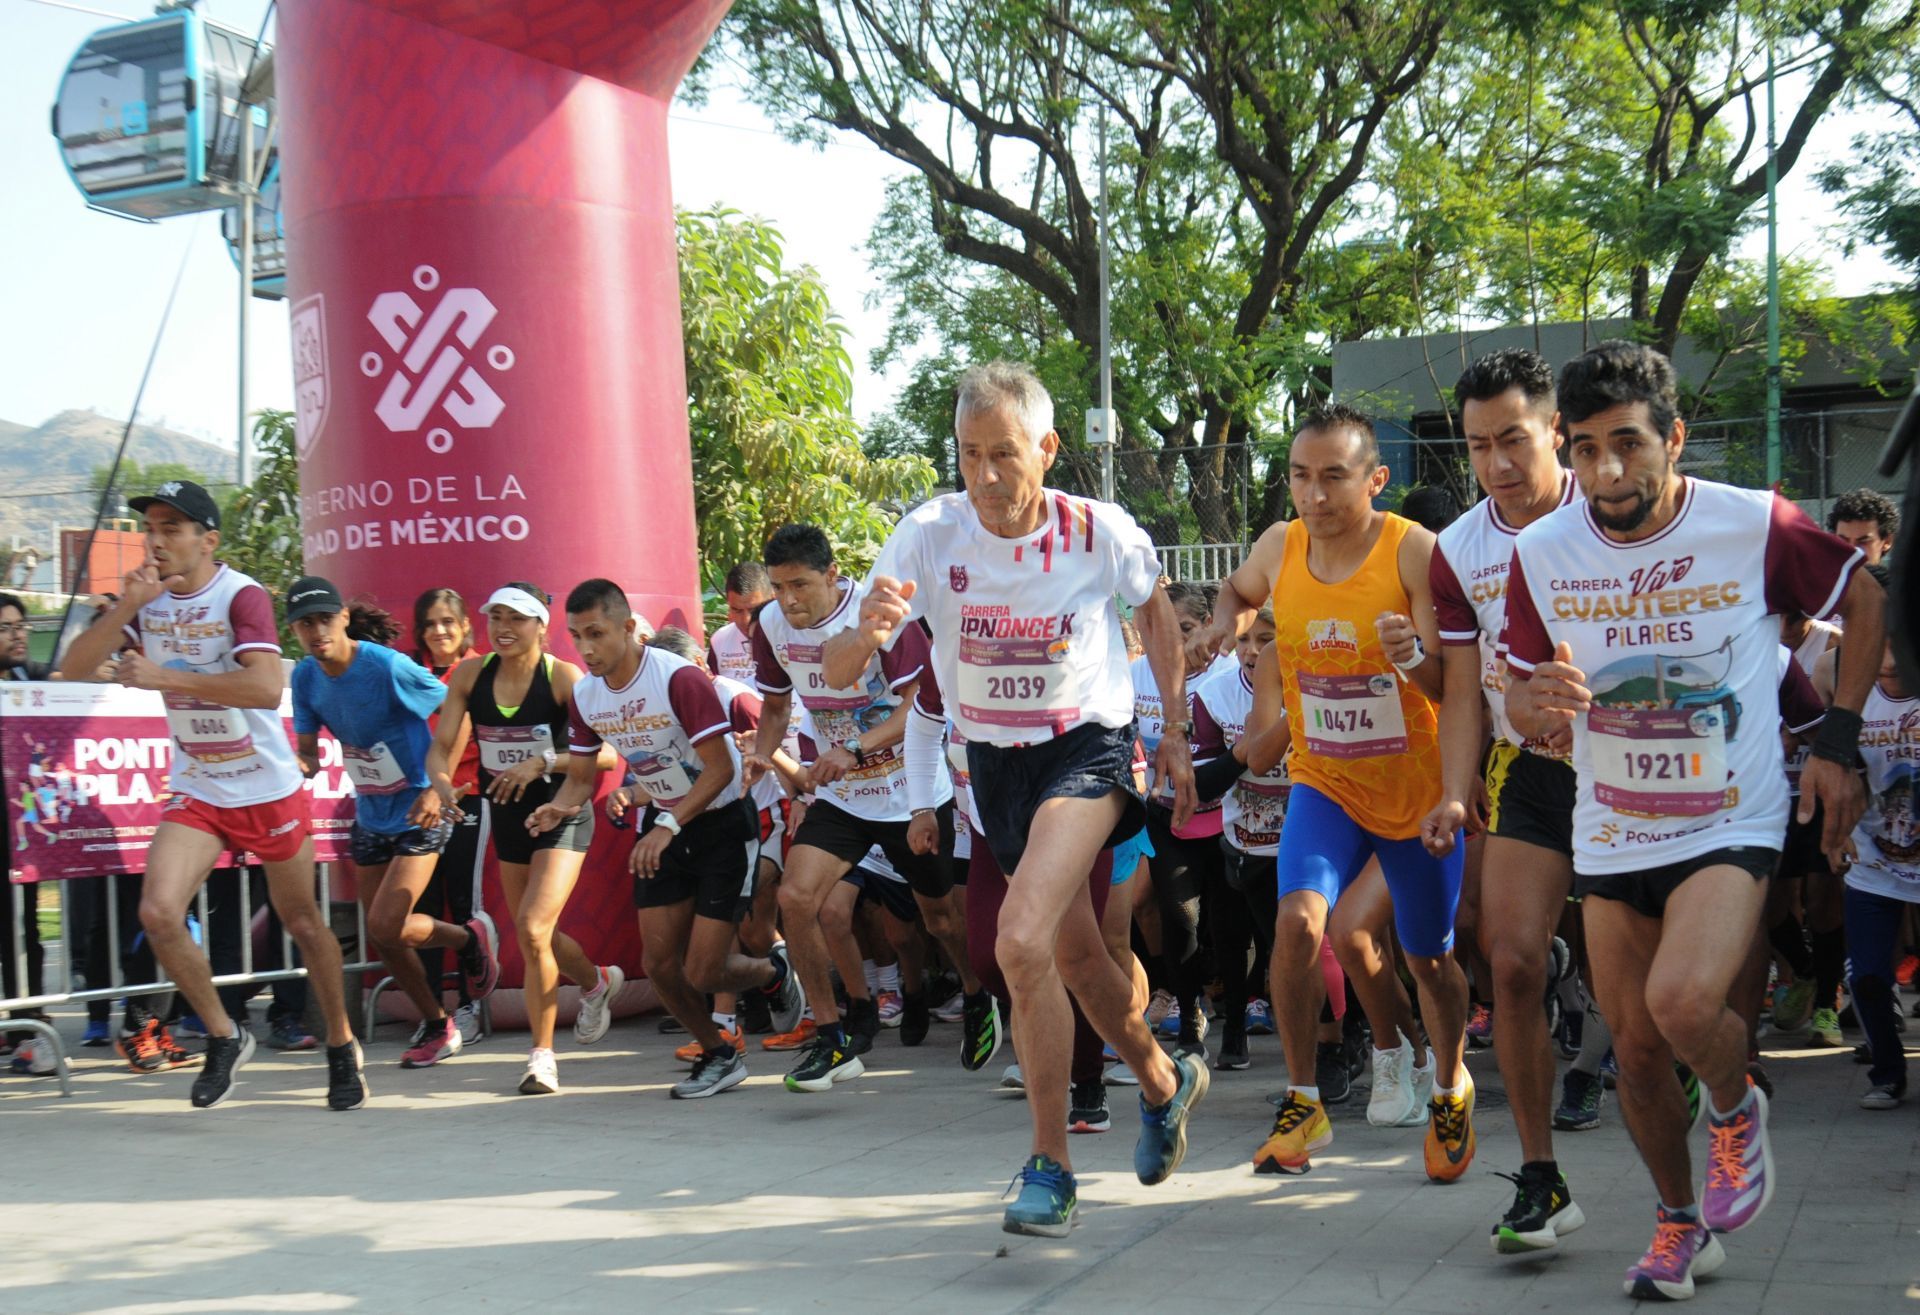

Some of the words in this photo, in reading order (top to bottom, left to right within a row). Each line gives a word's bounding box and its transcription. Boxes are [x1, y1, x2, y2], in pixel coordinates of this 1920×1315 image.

[408, 476, 459, 504] DE
[475, 474, 527, 502] LA
[304, 529, 340, 560] DAD
[345, 522, 382, 550] DE
[390, 511, 530, 546] MÉXICO
[1471, 562, 1511, 580] CARRE
[1550, 578, 1622, 592] CARRERA
[1552, 581, 1742, 621] CUAUTEPEC
[961, 605, 1010, 617] CARRERA
[961, 616, 1057, 638] IPNONCE
[1060, 612, 1076, 636] K
[1310, 641, 1320, 650] LA
[1321, 639, 1357, 652] COLMENA
[987, 676, 1046, 699] 2039
[1135, 694, 1162, 703] ARRER
[591, 713, 672, 736] CUAUTEPEC
[1323, 708, 1374, 733] 0474
[617, 734, 654, 749] PILARES
[1857, 729, 1920, 748] CUAUTE
[74, 738, 174, 770] PONT
[1886, 747, 1920, 762] PILARE
[1625, 752, 1686, 779] 1921
[854, 786, 892, 798] PONTE
[1891, 866, 1920, 883] PONT
